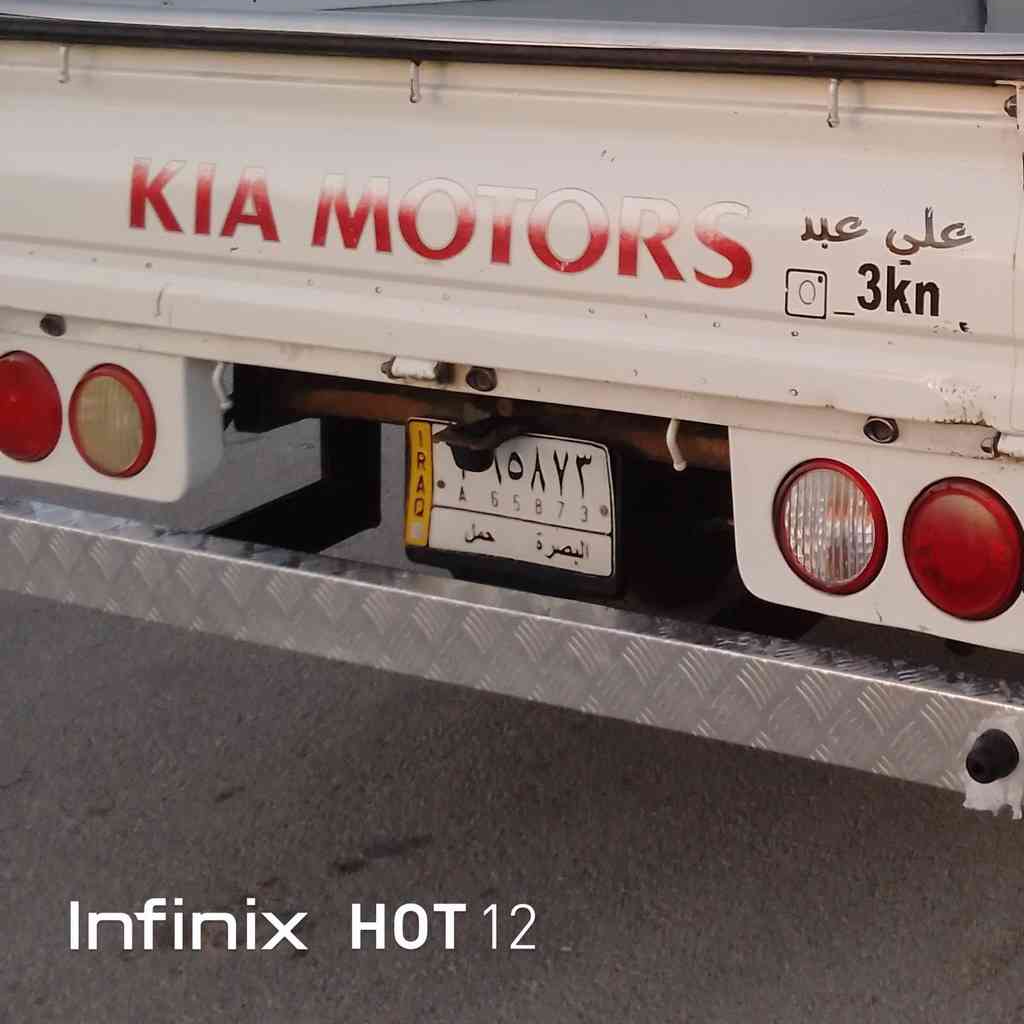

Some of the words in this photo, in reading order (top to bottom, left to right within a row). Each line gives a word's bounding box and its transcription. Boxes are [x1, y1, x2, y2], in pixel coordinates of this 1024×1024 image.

[129, 157, 281, 243] KIA
[310, 168, 753, 290] MOTORS
[413, 430, 425, 517] IRAQ
[536, 532, 589, 566] البصرة
